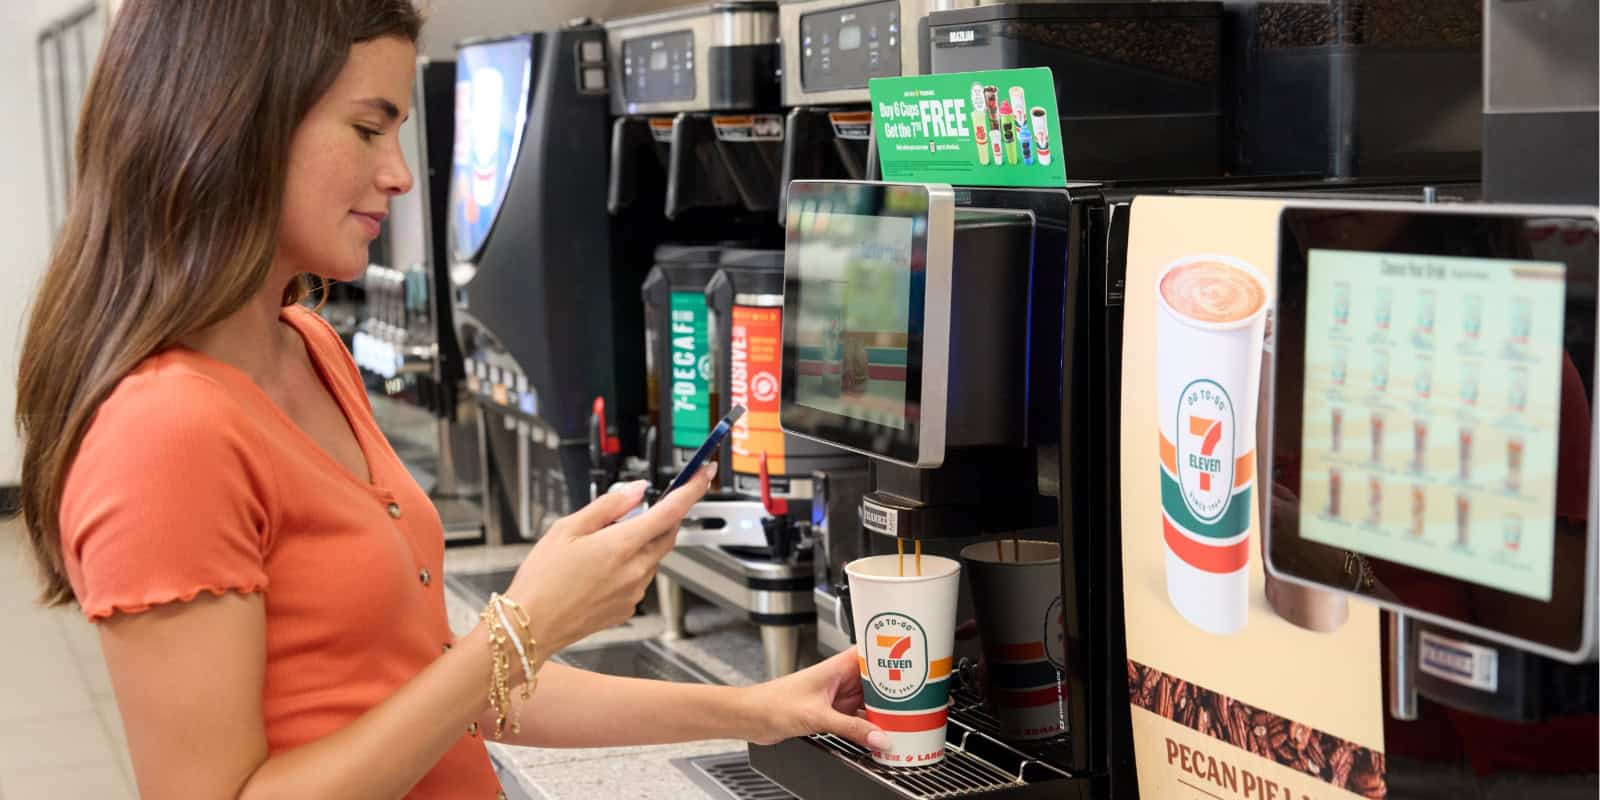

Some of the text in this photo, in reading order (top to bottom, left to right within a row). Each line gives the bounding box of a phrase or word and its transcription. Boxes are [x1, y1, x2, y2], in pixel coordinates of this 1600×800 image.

[879, 101, 920, 120] Buy 6 Cups
[884, 122, 898, 138] Get
[897, 122, 912, 138] the
[919, 98, 970, 137] FREE
[672, 324, 697, 413] 7-DECAF
[1188, 453, 1222, 473] ELEVEN
[1189, 415, 1222, 493] 7
[876, 635, 912, 681] 7
[877, 658, 912, 669] ELEVEN
[1165, 737, 1238, 793] PECAN
